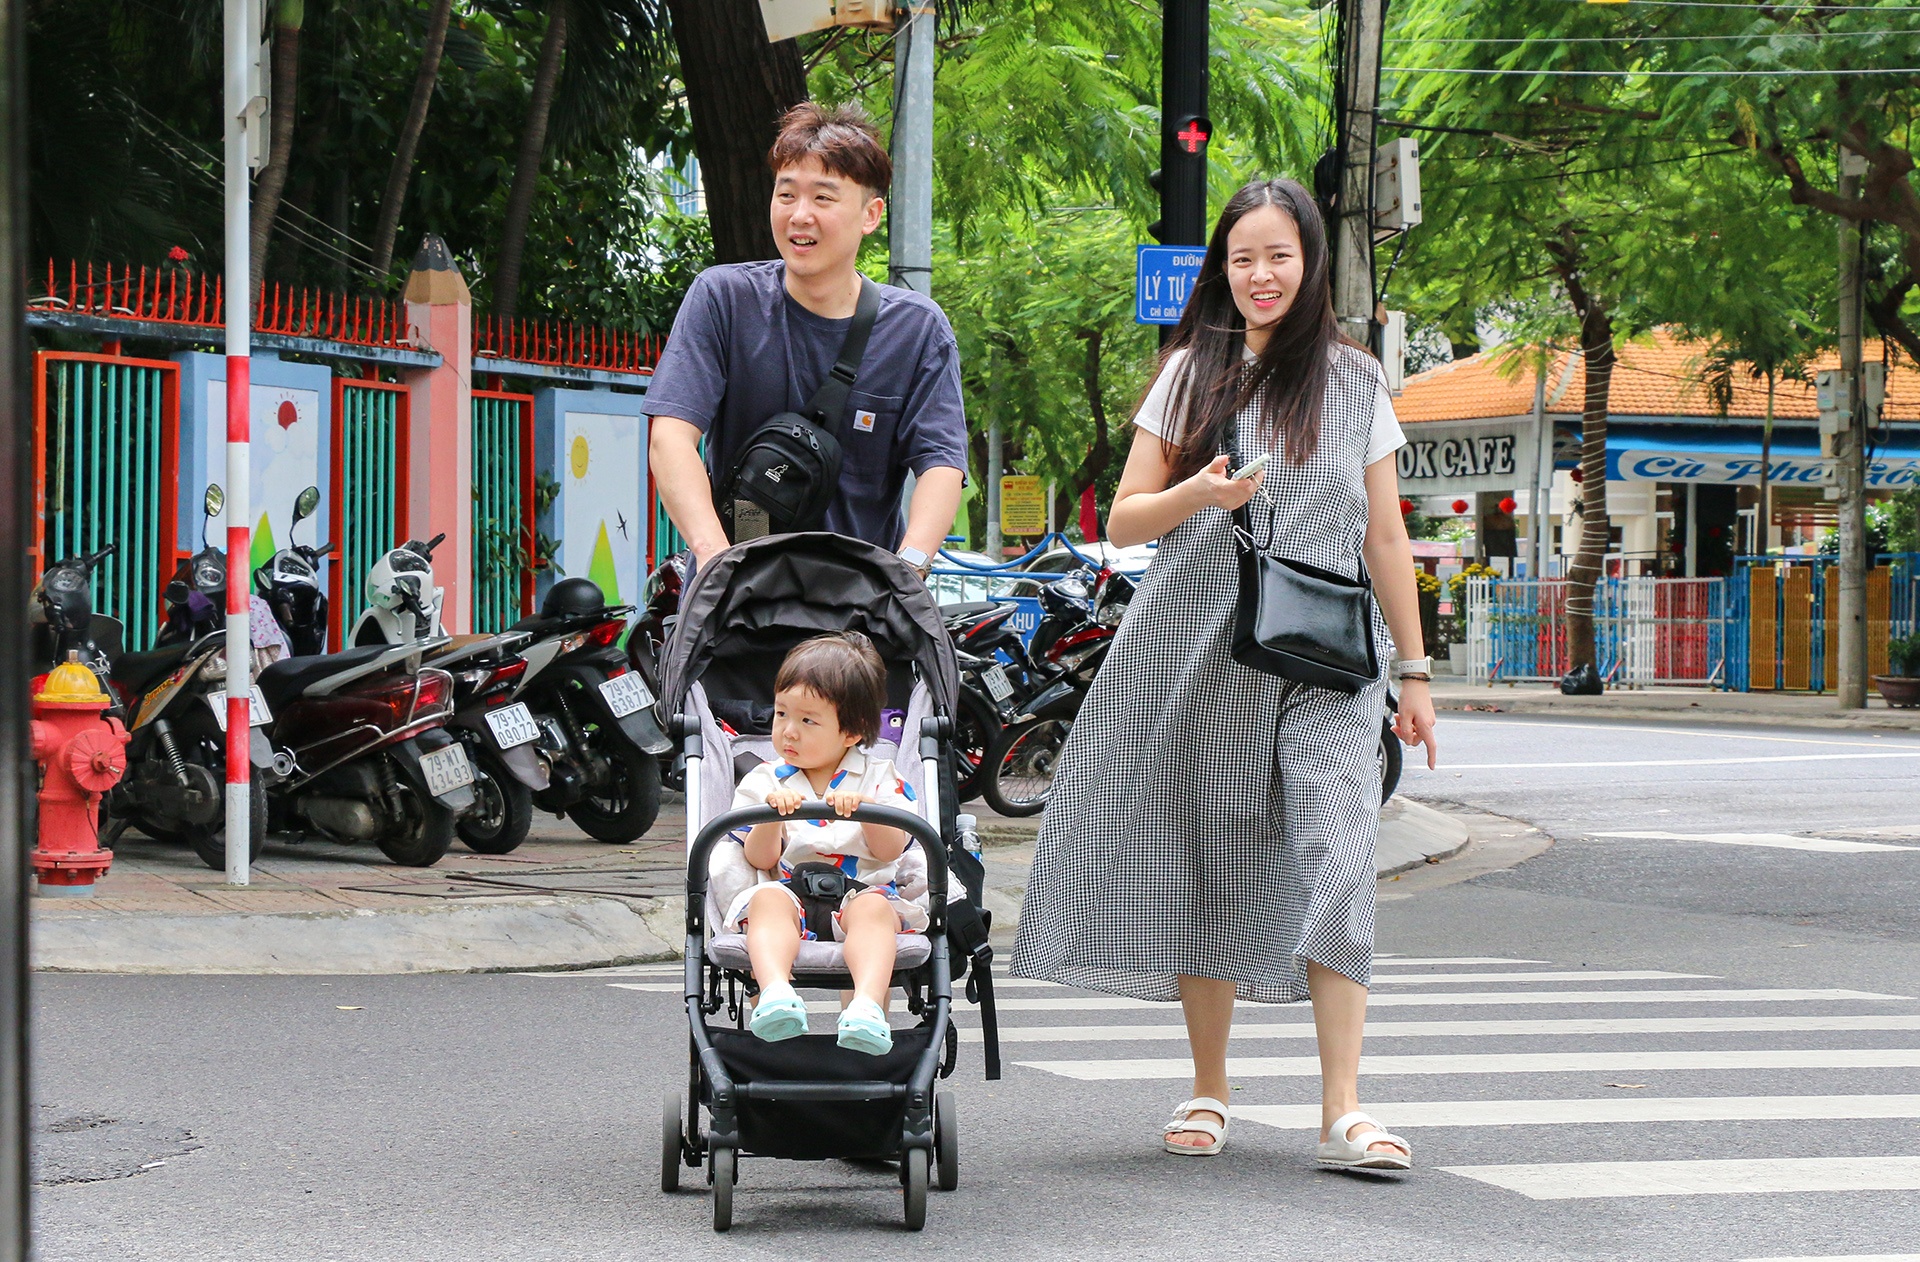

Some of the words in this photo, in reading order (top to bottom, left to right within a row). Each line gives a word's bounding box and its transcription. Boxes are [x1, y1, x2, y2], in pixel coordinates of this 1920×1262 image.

[1172, 252, 1204, 267] ĐƯỜN
[1145, 270, 1162, 301] LÝ
[1167, 272, 1187, 305] TỰ
[1397, 440, 1438, 479] OK
[1440, 434, 1516, 478] CAFE
[1632, 456, 1706, 479] Cà
[611, 688, 650, 715] 638.77
[492, 707, 524, 730] 79-X1
[499, 721, 538, 746] 090.72
[430, 764, 471, 792] 434.93
